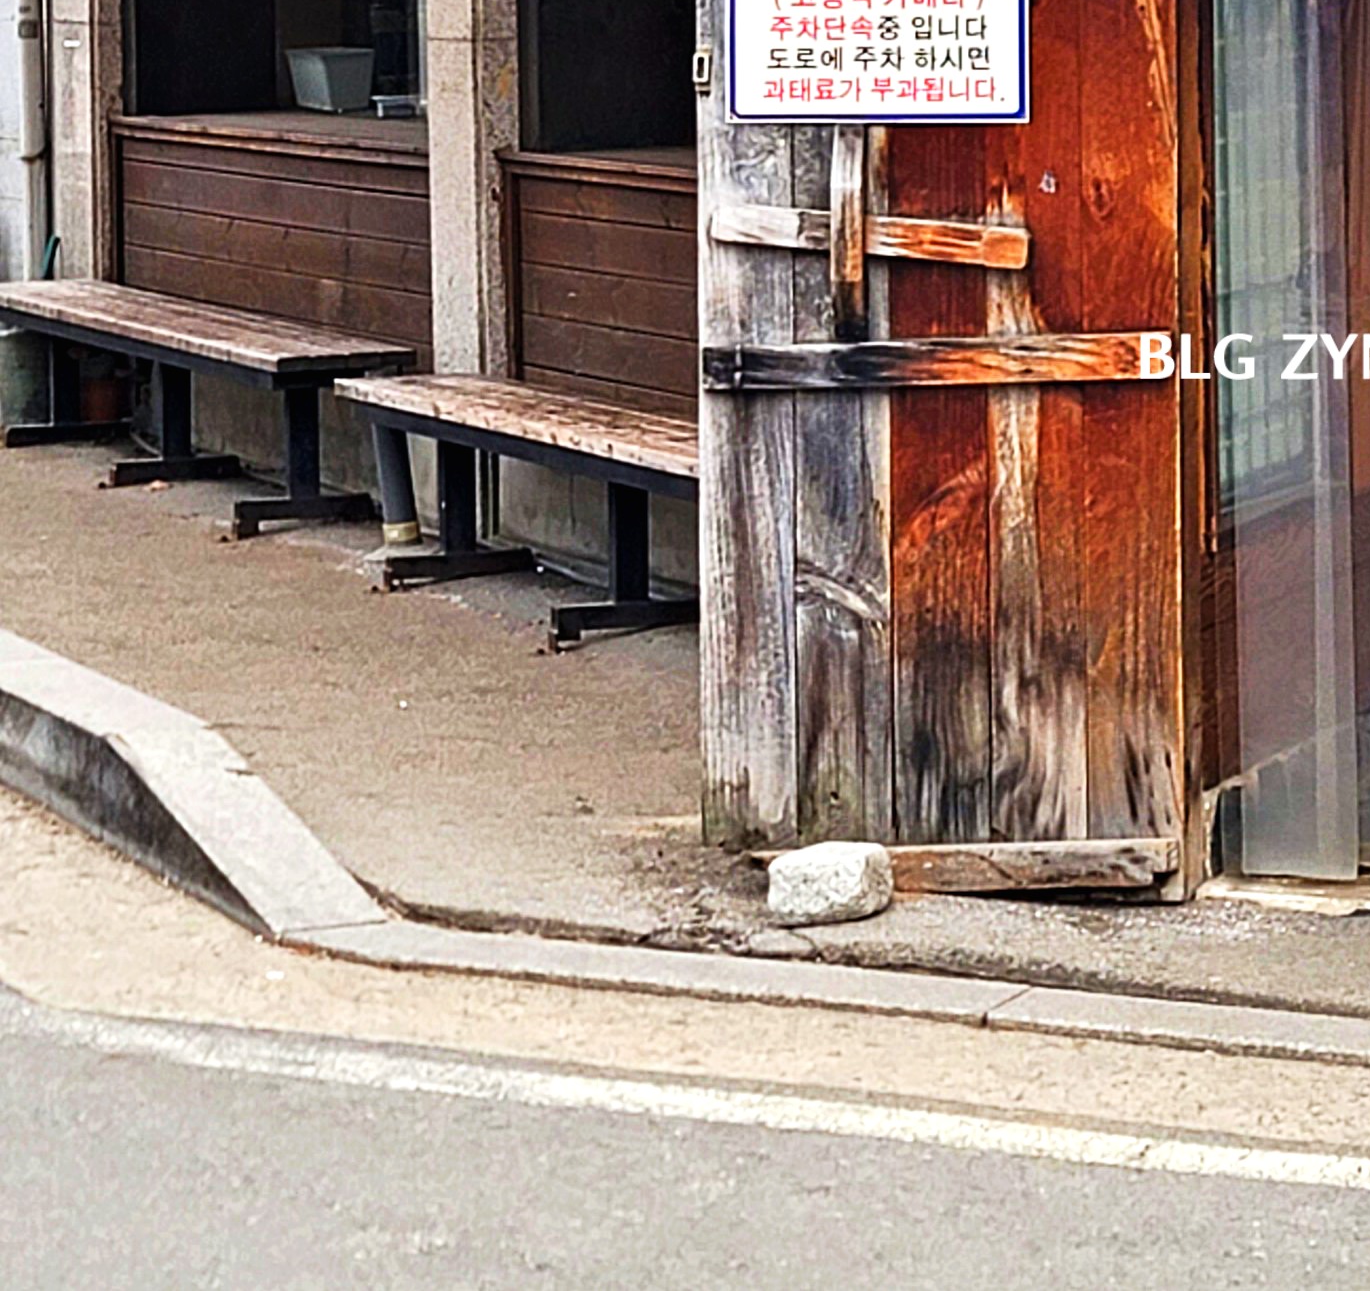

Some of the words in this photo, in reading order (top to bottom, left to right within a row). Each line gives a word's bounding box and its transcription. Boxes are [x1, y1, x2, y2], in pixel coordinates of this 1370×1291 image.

[770, 15, 901, 41] 주차단속중
[911, 14, 987, 41] 입니다
[767, 46, 843, 72] 도로에
[853, 45, 903, 72] 주차
[763, 77, 861, 102] 과태료가
[871, 77, 1005, 102] 부과됩니다.
